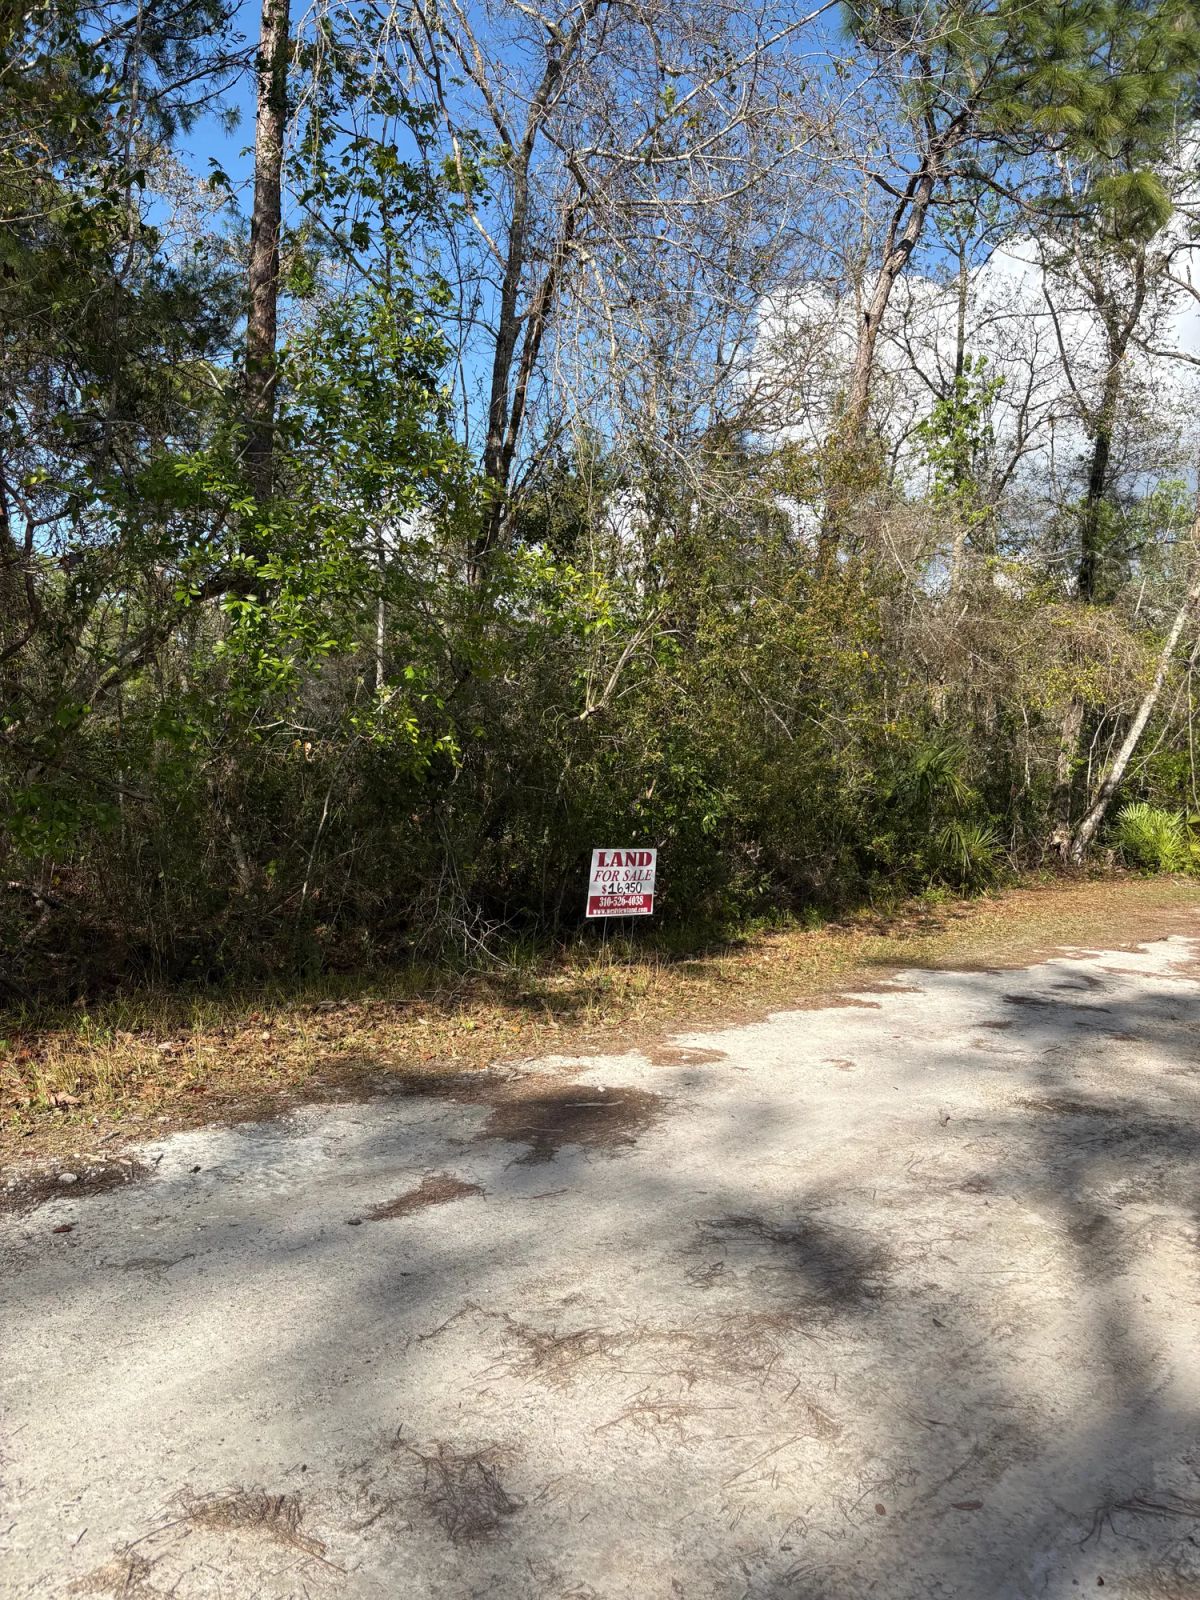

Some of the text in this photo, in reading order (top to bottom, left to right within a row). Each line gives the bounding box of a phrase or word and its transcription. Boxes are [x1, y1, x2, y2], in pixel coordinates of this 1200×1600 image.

[597, 852, 653, 867] LAND
[593, 869, 652, 882] FOR SALE
[599, 896, 643, 907] 310-526-4038
